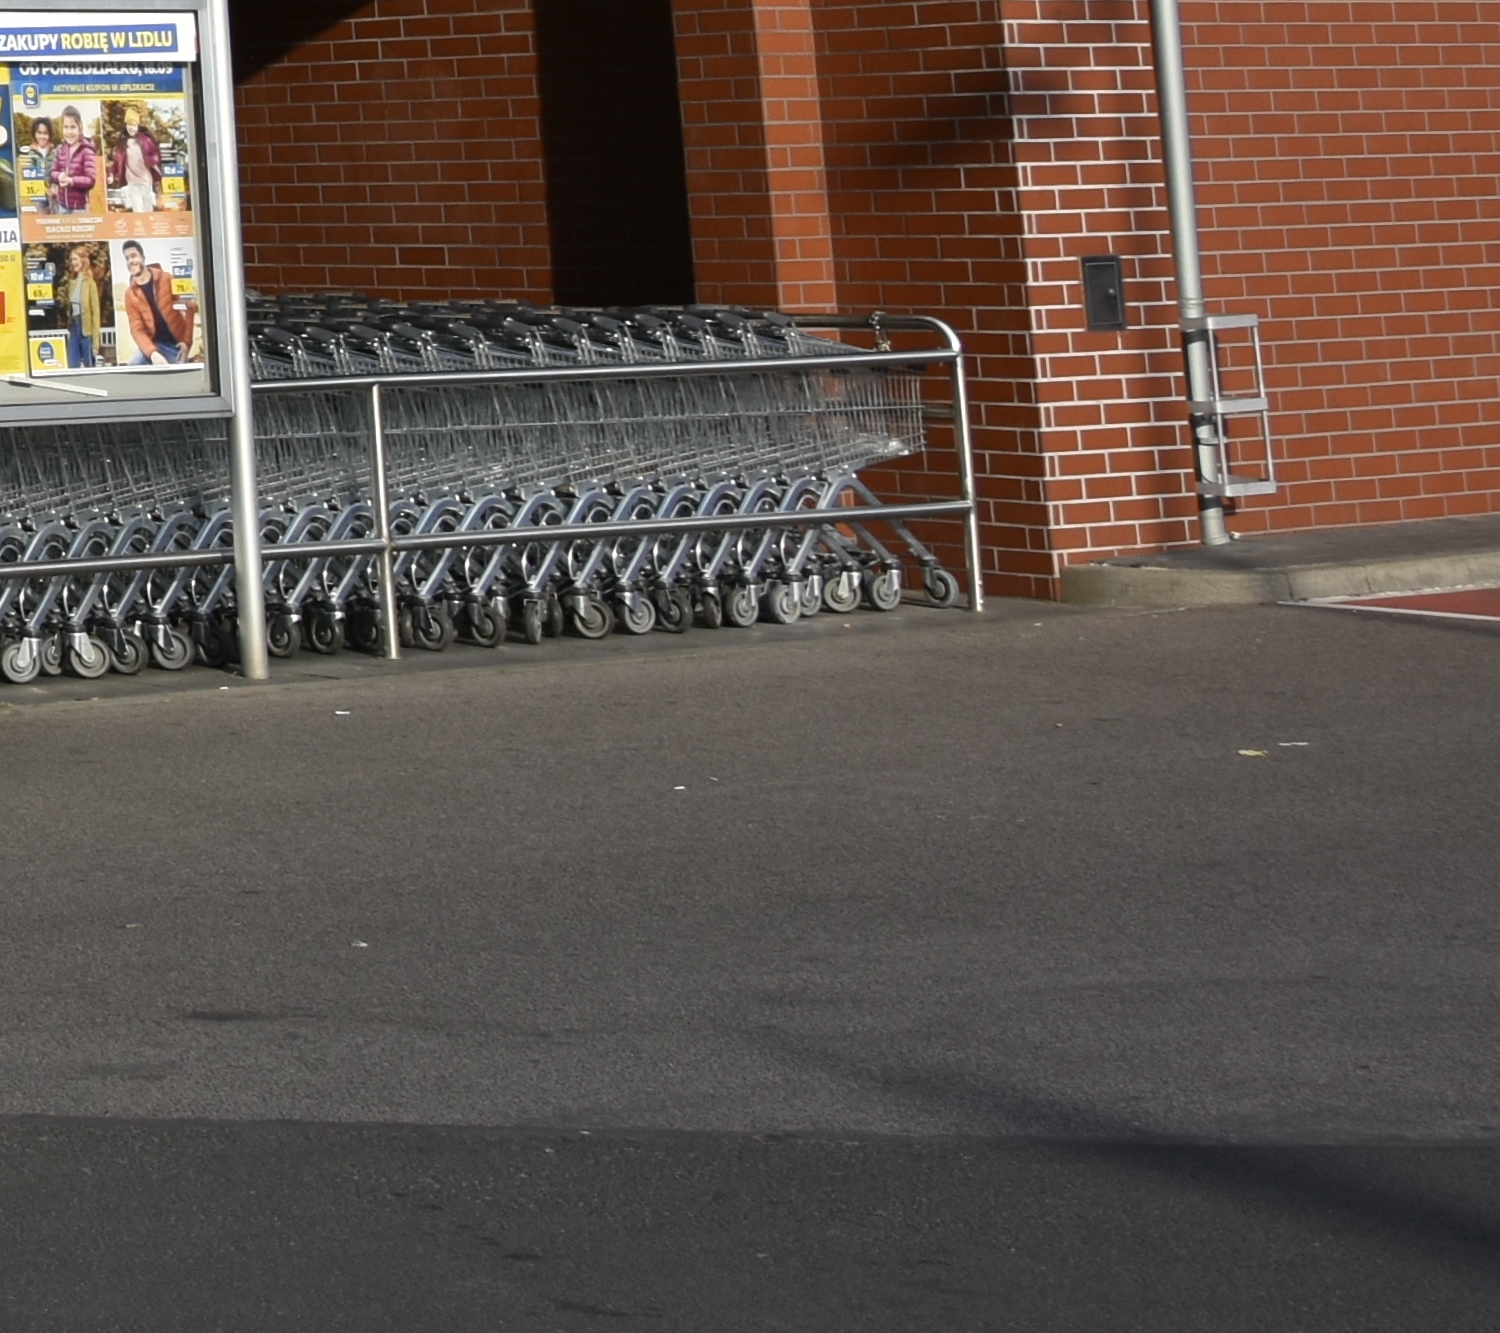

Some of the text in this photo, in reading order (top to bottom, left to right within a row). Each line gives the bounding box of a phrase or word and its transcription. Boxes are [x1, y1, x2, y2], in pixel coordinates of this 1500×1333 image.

[61, 32, 109, 52] ROBIĘ
[110, 32, 125, 48] W
[129, 31, 173, 48] LIDLU
